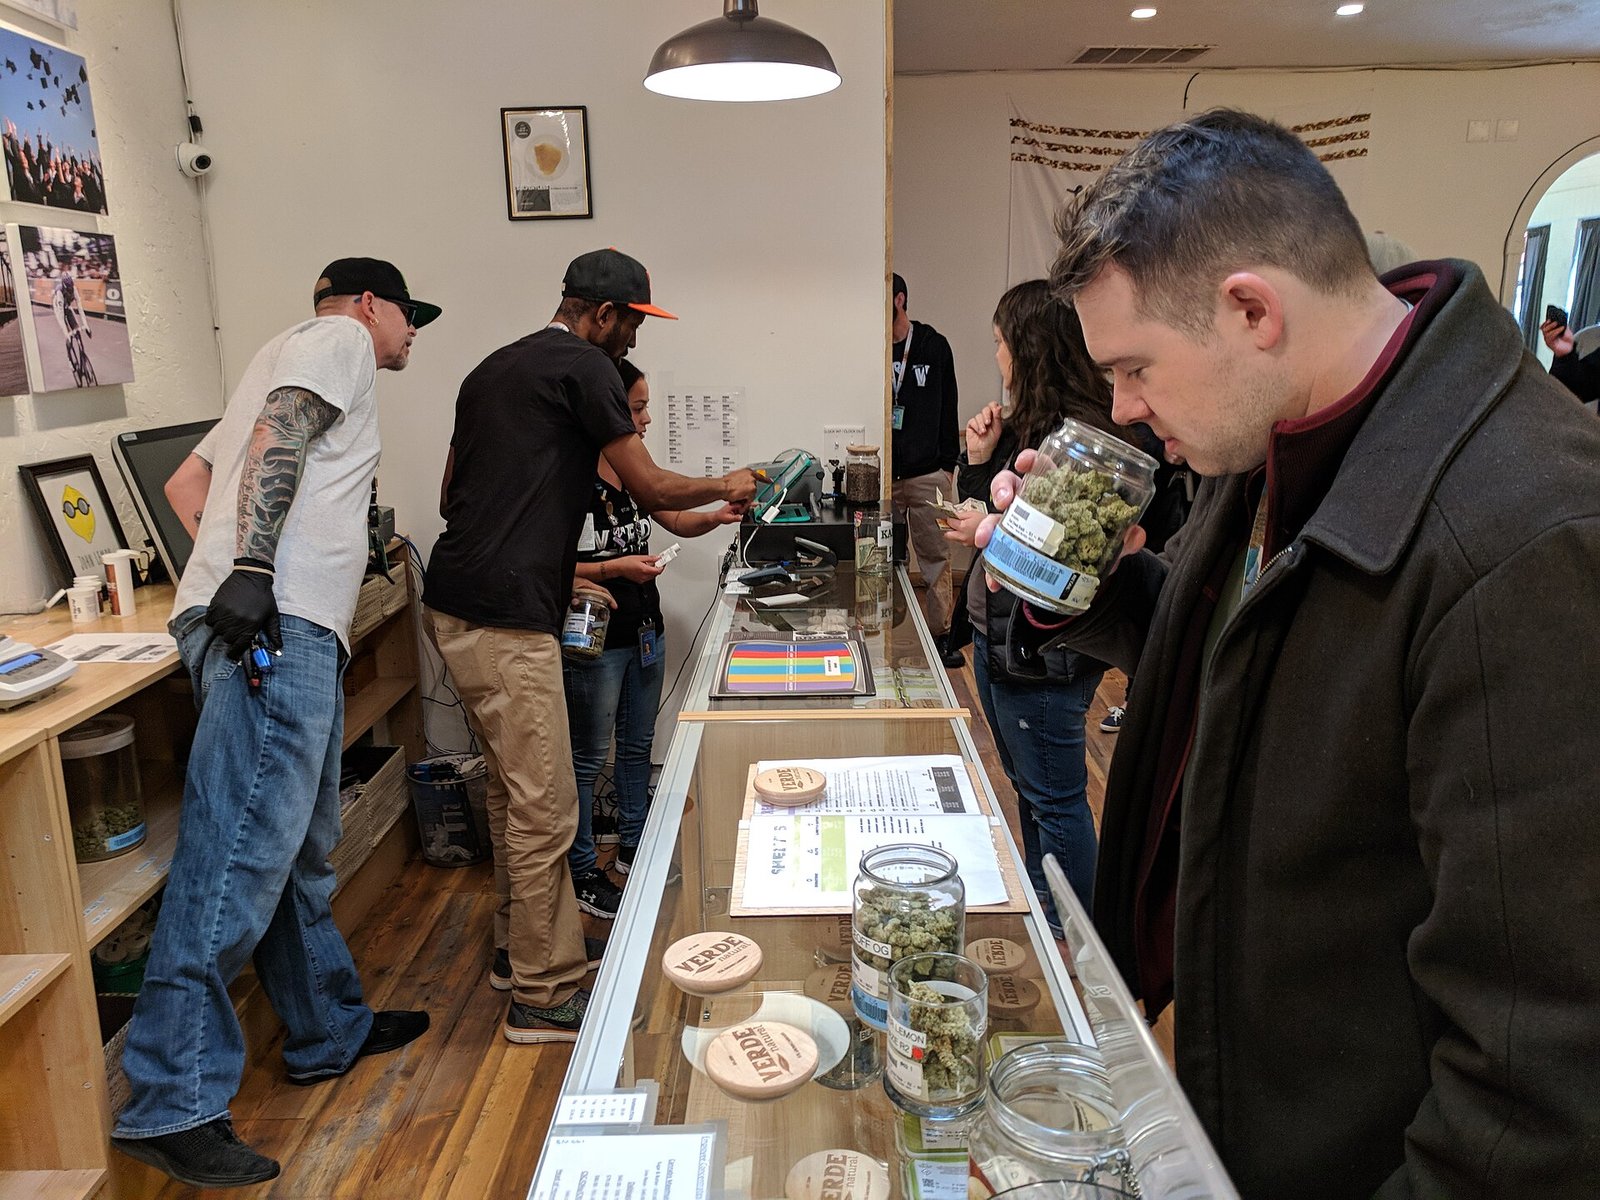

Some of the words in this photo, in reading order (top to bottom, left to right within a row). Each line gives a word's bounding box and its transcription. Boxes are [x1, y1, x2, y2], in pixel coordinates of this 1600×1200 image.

[912, 364, 931, 387] W
[776, 768, 798, 791] VERDE
[675, 936, 743, 973] VERDE
[717, 942, 751, 962] natural
[873, 944, 889, 956] OG
[753, 1024, 780, 1052] natural
[895, 1023, 924, 1044] LEMON
[732, 1027, 784, 1083] VERDE
[820, 1154, 848, 1200] ERDE
[846, 1156, 858, 1187] natural
